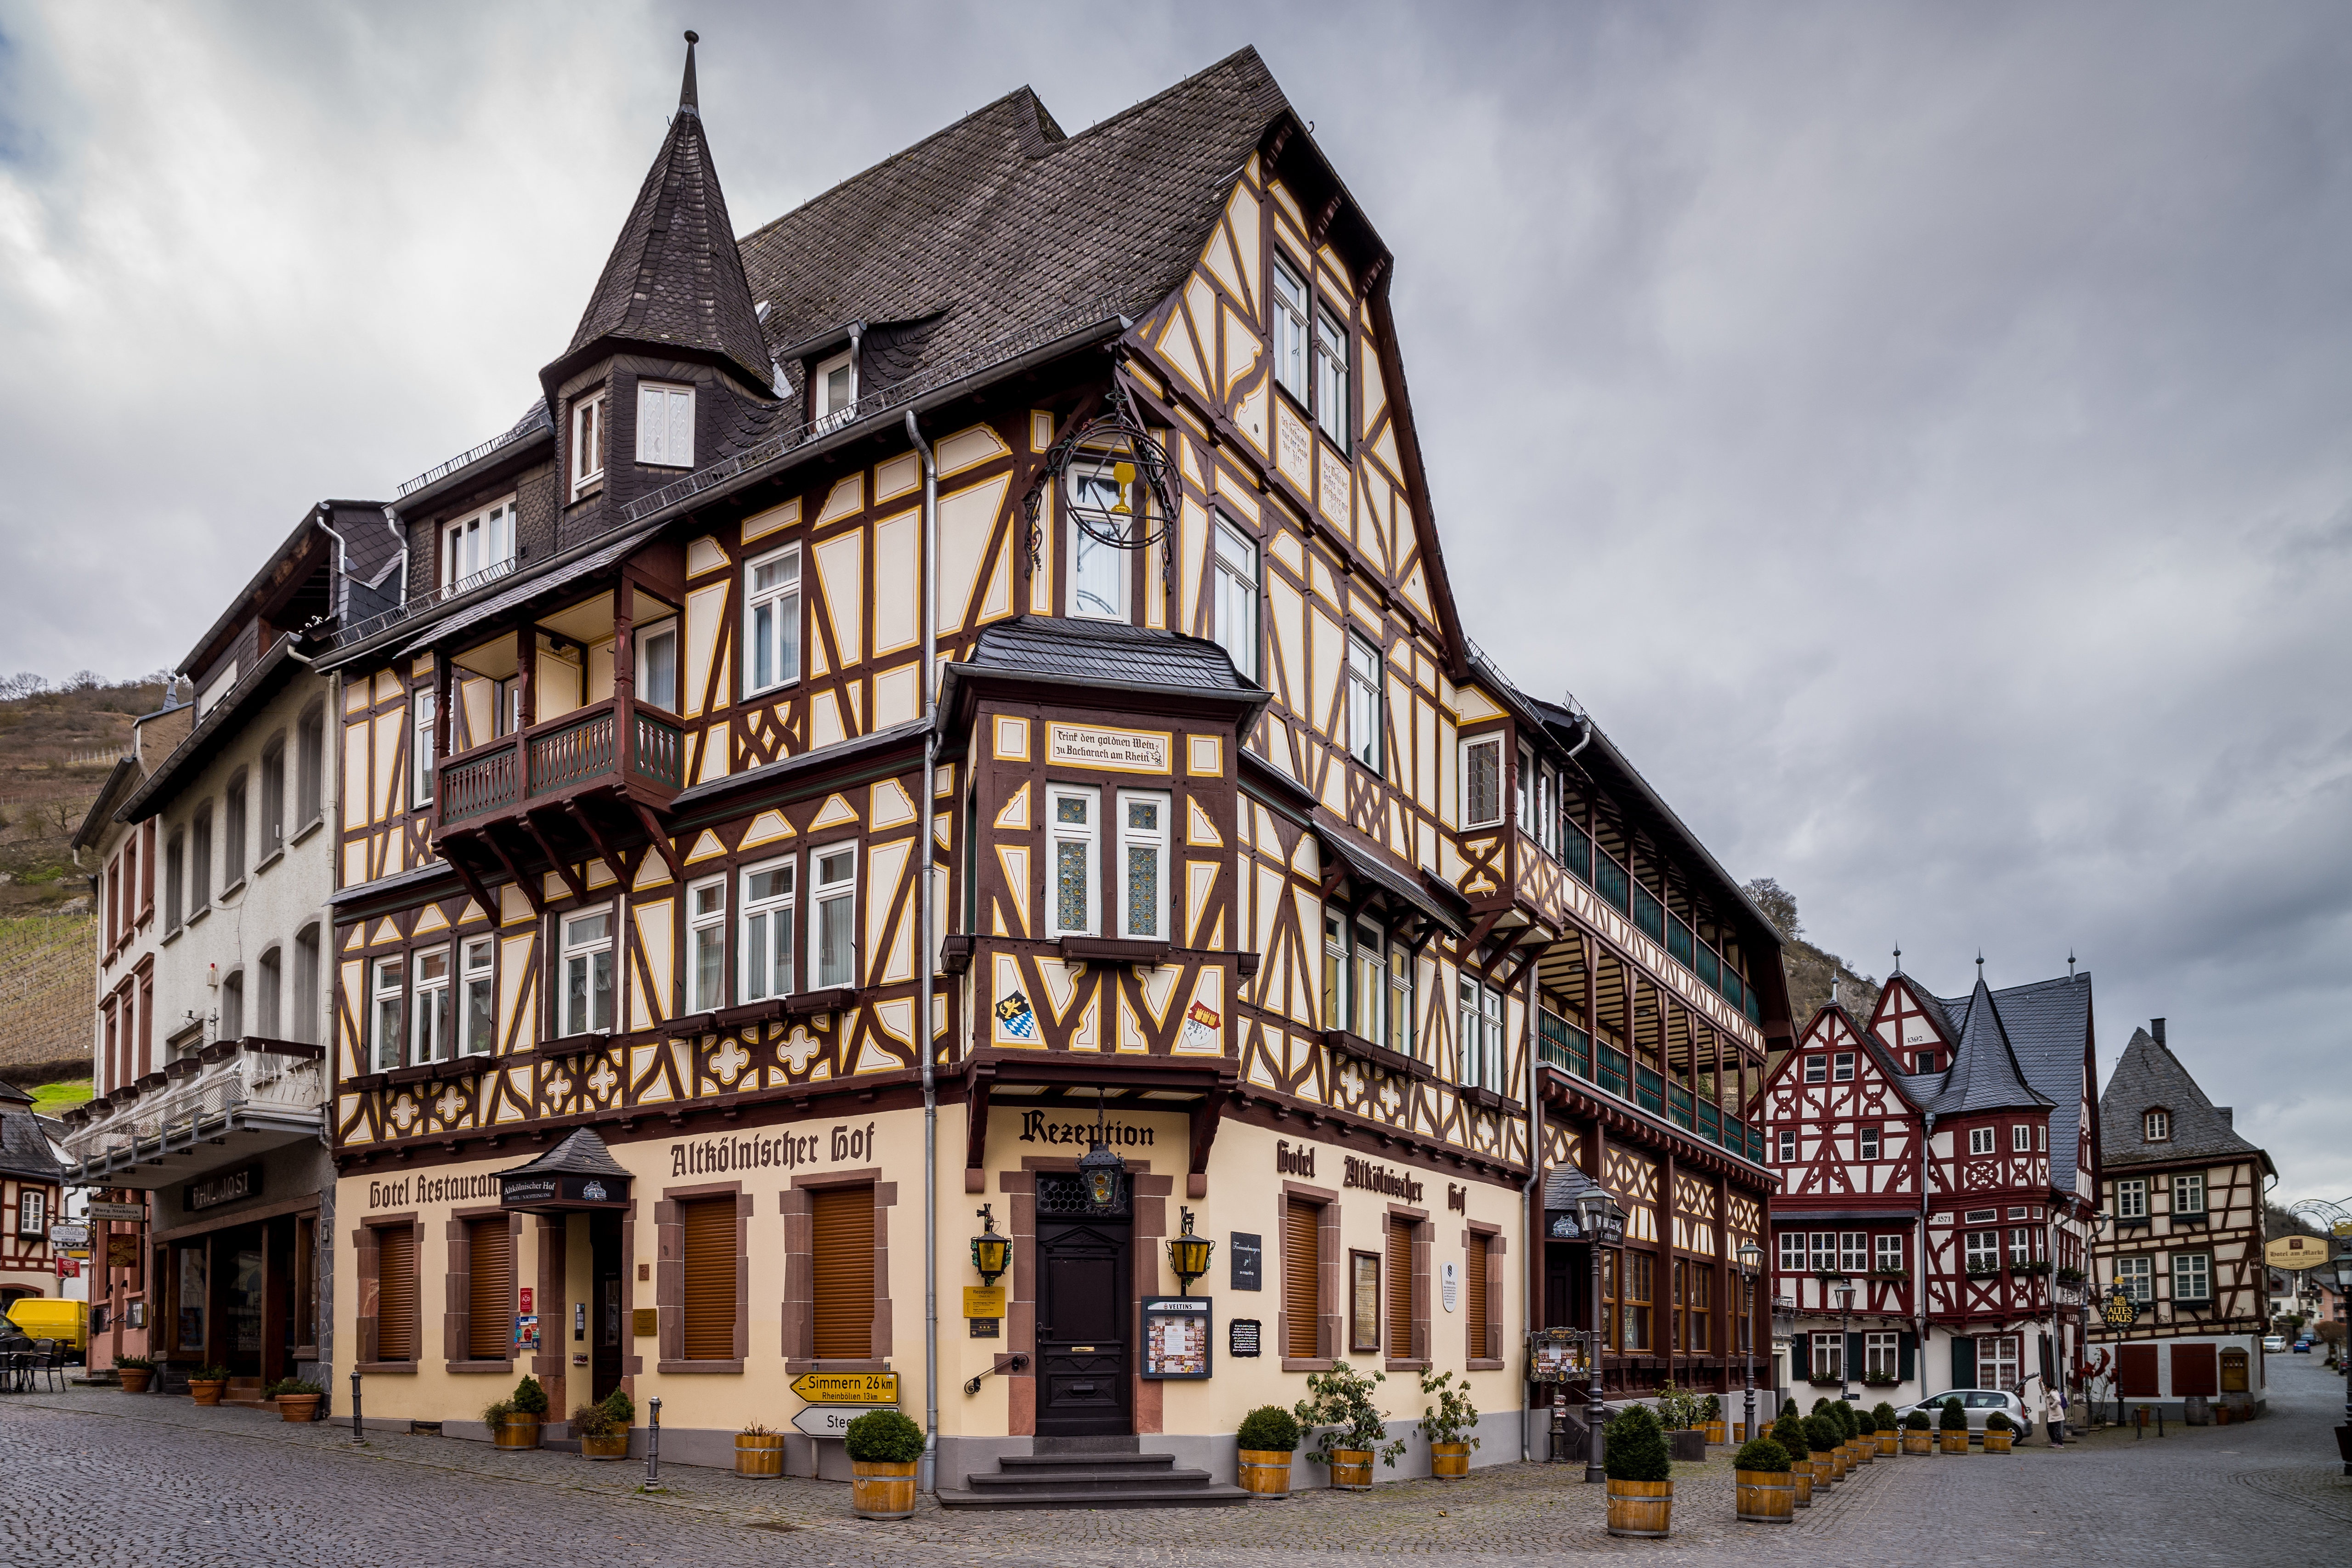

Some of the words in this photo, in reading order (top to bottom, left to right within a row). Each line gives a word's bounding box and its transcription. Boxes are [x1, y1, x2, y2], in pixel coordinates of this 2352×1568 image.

[1057, 730, 1078, 742] Trink
[1080, 733, 1095, 743] den
[1097, 736, 1130, 747] goldnen
[1132, 738, 1154, 750] Wein
[1067, 745, 1109, 759] Bacharach
[1110, 752, 1123, 760] am
[1125, 751, 1150, 762] Rhein
[1018, 1109, 1154, 1153] Rezeption
[670, 1130, 819, 1177] Altkölnischer
[831, 1121, 875, 1163] Hof
[1277, 1139, 1316, 1178] Hotel
[220, 1171, 249, 1199] JOST
[370, 1176, 410, 1209] Hotel
[415, 1174, 502, 1204] Restauran
[504, 1182, 542, 1195] Altkölnischer
[543, 1181, 556, 1190] Hof
[1343, 1155, 1424, 1205] Altkölnischer
[1448, 1182, 1467, 1216] Hof
[808, 1376, 860, 1389] Simmern
[866, 1376, 879, 1389] 26
[882, 1378, 893, 1389] km
[827, 1415, 852, 1428] Stee
